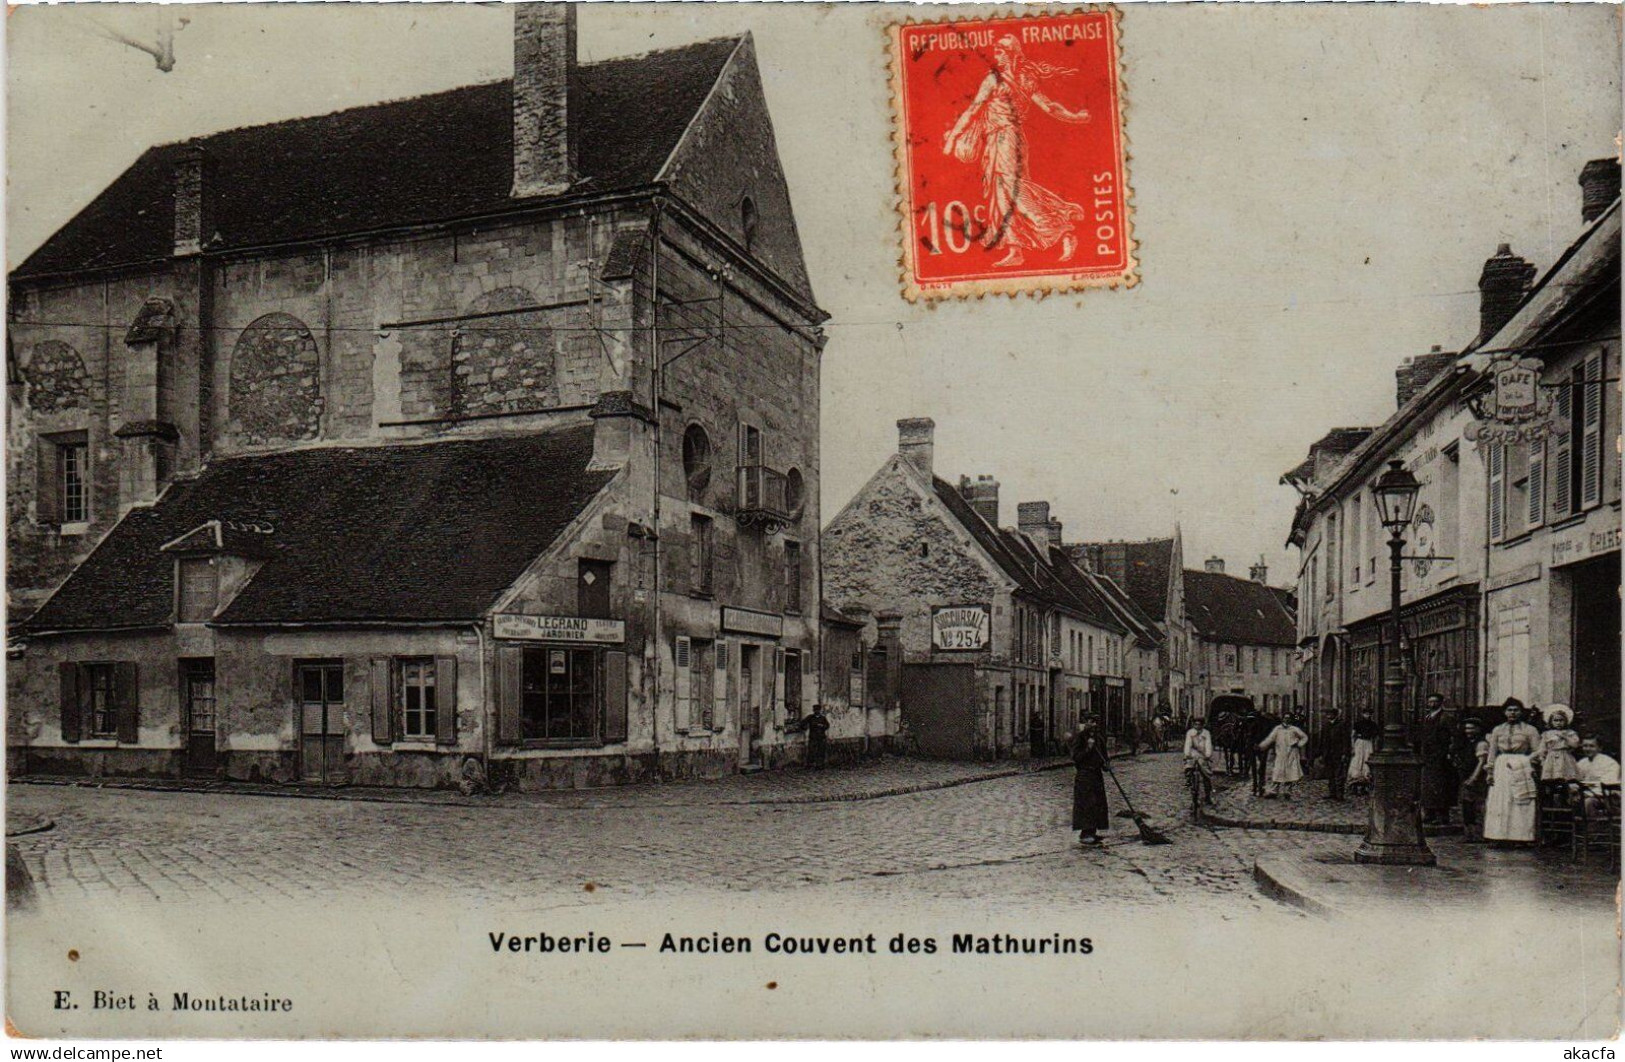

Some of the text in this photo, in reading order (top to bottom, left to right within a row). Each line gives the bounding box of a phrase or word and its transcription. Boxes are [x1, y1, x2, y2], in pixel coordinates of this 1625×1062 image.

[1094, 170, 1116, 255] POSTES
[537, 617, 588, 631] LEGRAND
[934, 610, 988, 630] SUCCURSALE
[541, 629, 585, 640] JARDINIER
[956, 630, 982, 648] 254
